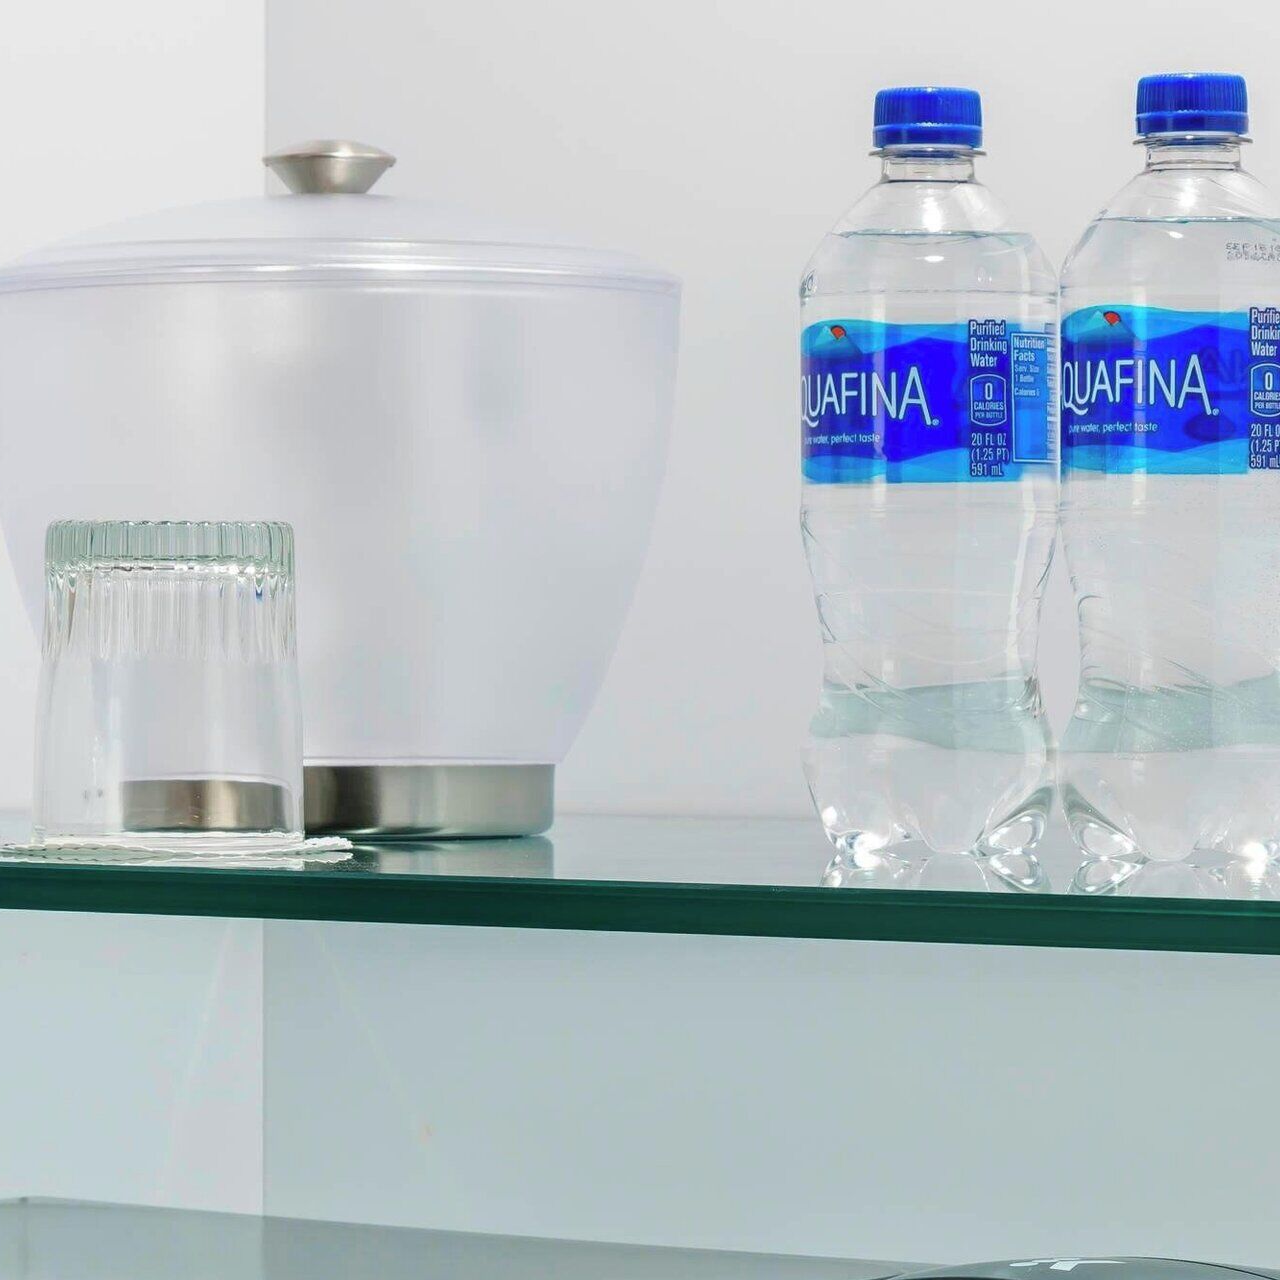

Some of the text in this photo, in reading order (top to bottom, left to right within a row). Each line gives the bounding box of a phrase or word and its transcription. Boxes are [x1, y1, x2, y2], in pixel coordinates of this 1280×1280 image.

[970, 321, 1005, 336] Purified
[970, 337, 1007, 355] Drinking
[1014, 337, 1045, 349] Nutrition
[1251, 342, 1278, 356] Water
[970, 353, 998, 367] Water
[1014, 350, 1036, 361] Facts
[1061, 354, 1212, 416] QUAFINA
[1265, 372, 1273, 390] 0
[800, 366, 932, 428] QUAFINA
[985, 382, 993, 400] 0
[974, 401, 1004, 411] CALORIES
[1102, 421, 1132, 434] perfect
[1134, 422, 1158, 432] taste
[1251, 424, 1262, 437] 20
[1264, 424, 1273, 437] FL
[830, 433, 857, 445] perfect
[859, 433, 880, 443] taste
[971, 432, 1007, 446] 20 FL OZ
[1251, 439, 1272, 454] (1.25
[971, 448, 1010, 464] (1.25 PT)
[1251, 455, 1280, 468] 591 mL
[971, 463, 1003, 476] 591 mL
